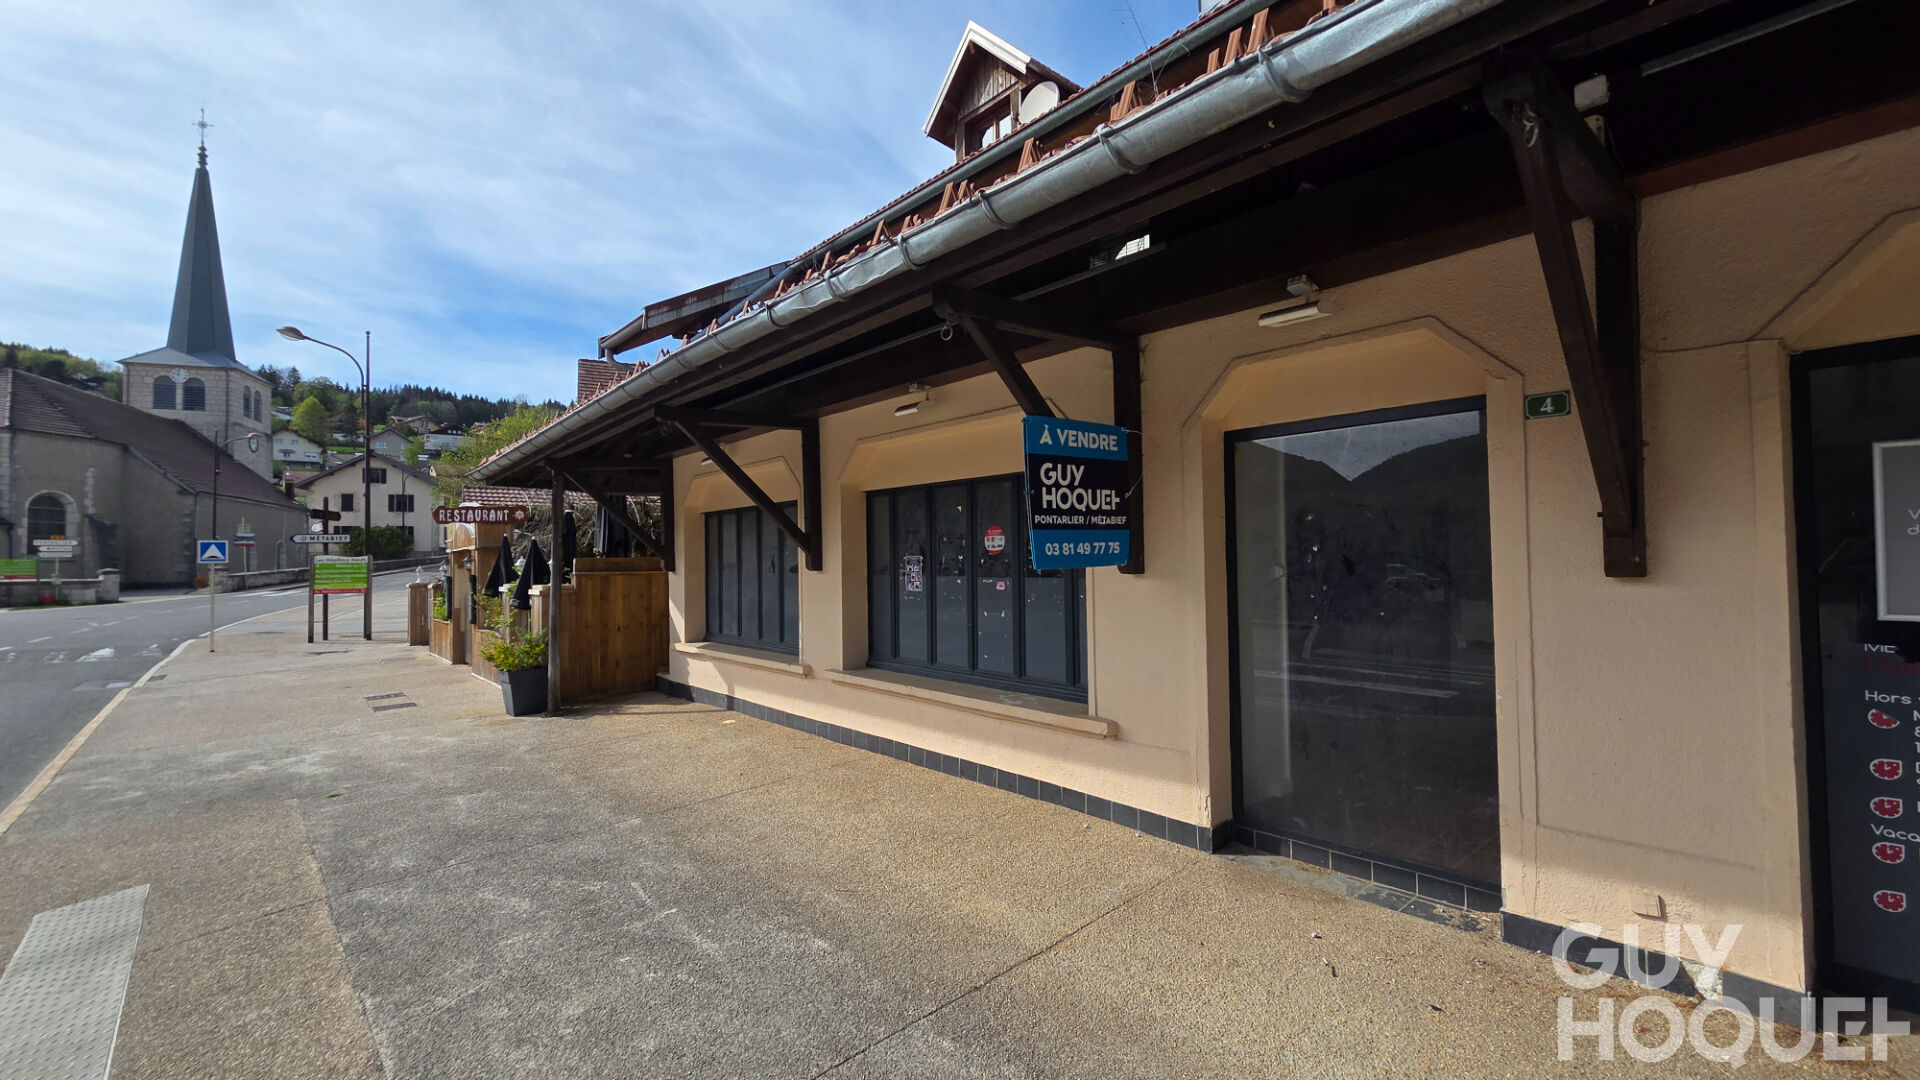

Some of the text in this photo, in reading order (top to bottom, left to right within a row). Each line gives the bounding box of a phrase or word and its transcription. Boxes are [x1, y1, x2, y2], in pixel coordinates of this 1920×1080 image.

[1540, 397, 1555, 413] 4
[1040, 424, 1118, 451] À VENDRE
[1040, 463, 1085, 486] GUY
[439, 509, 510, 522] RESTAURANT
[1034, 515, 1085, 525] PONTARLIER
[1091, 515, 1127, 525] MÉTABIEF
[1045, 541, 1121, 556] 03 81 49 77 75
[1864, 689, 1912, 704] Hors
